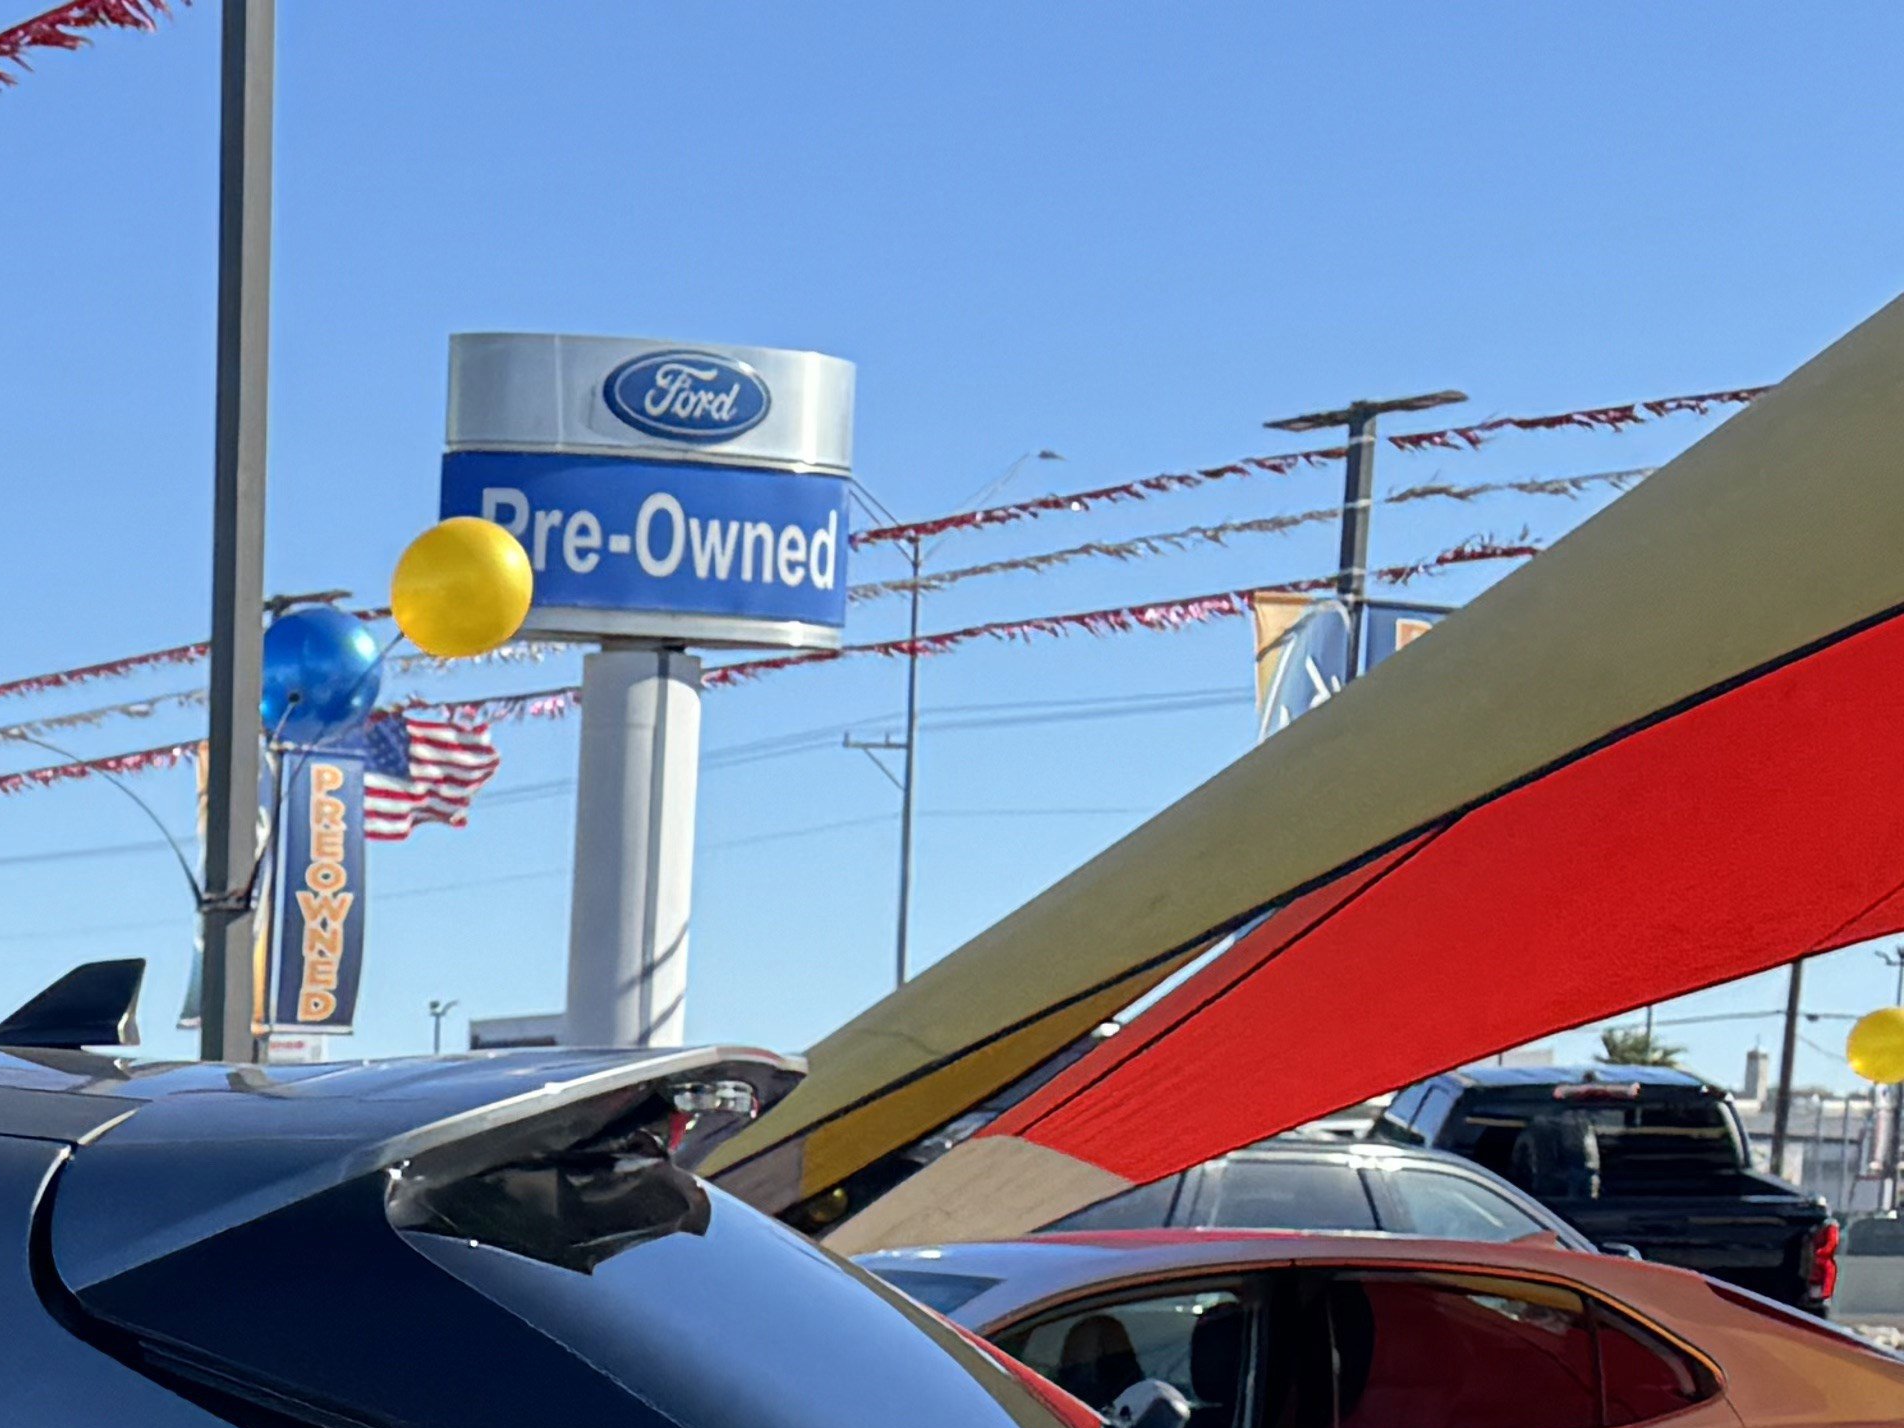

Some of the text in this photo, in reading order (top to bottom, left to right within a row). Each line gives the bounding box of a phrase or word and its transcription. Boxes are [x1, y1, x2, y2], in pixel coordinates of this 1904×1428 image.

[644, 363, 741, 423] Ford
[482, 487, 838, 590] Pre-Owned
[296, 763, 354, 1022] PREOWNED
